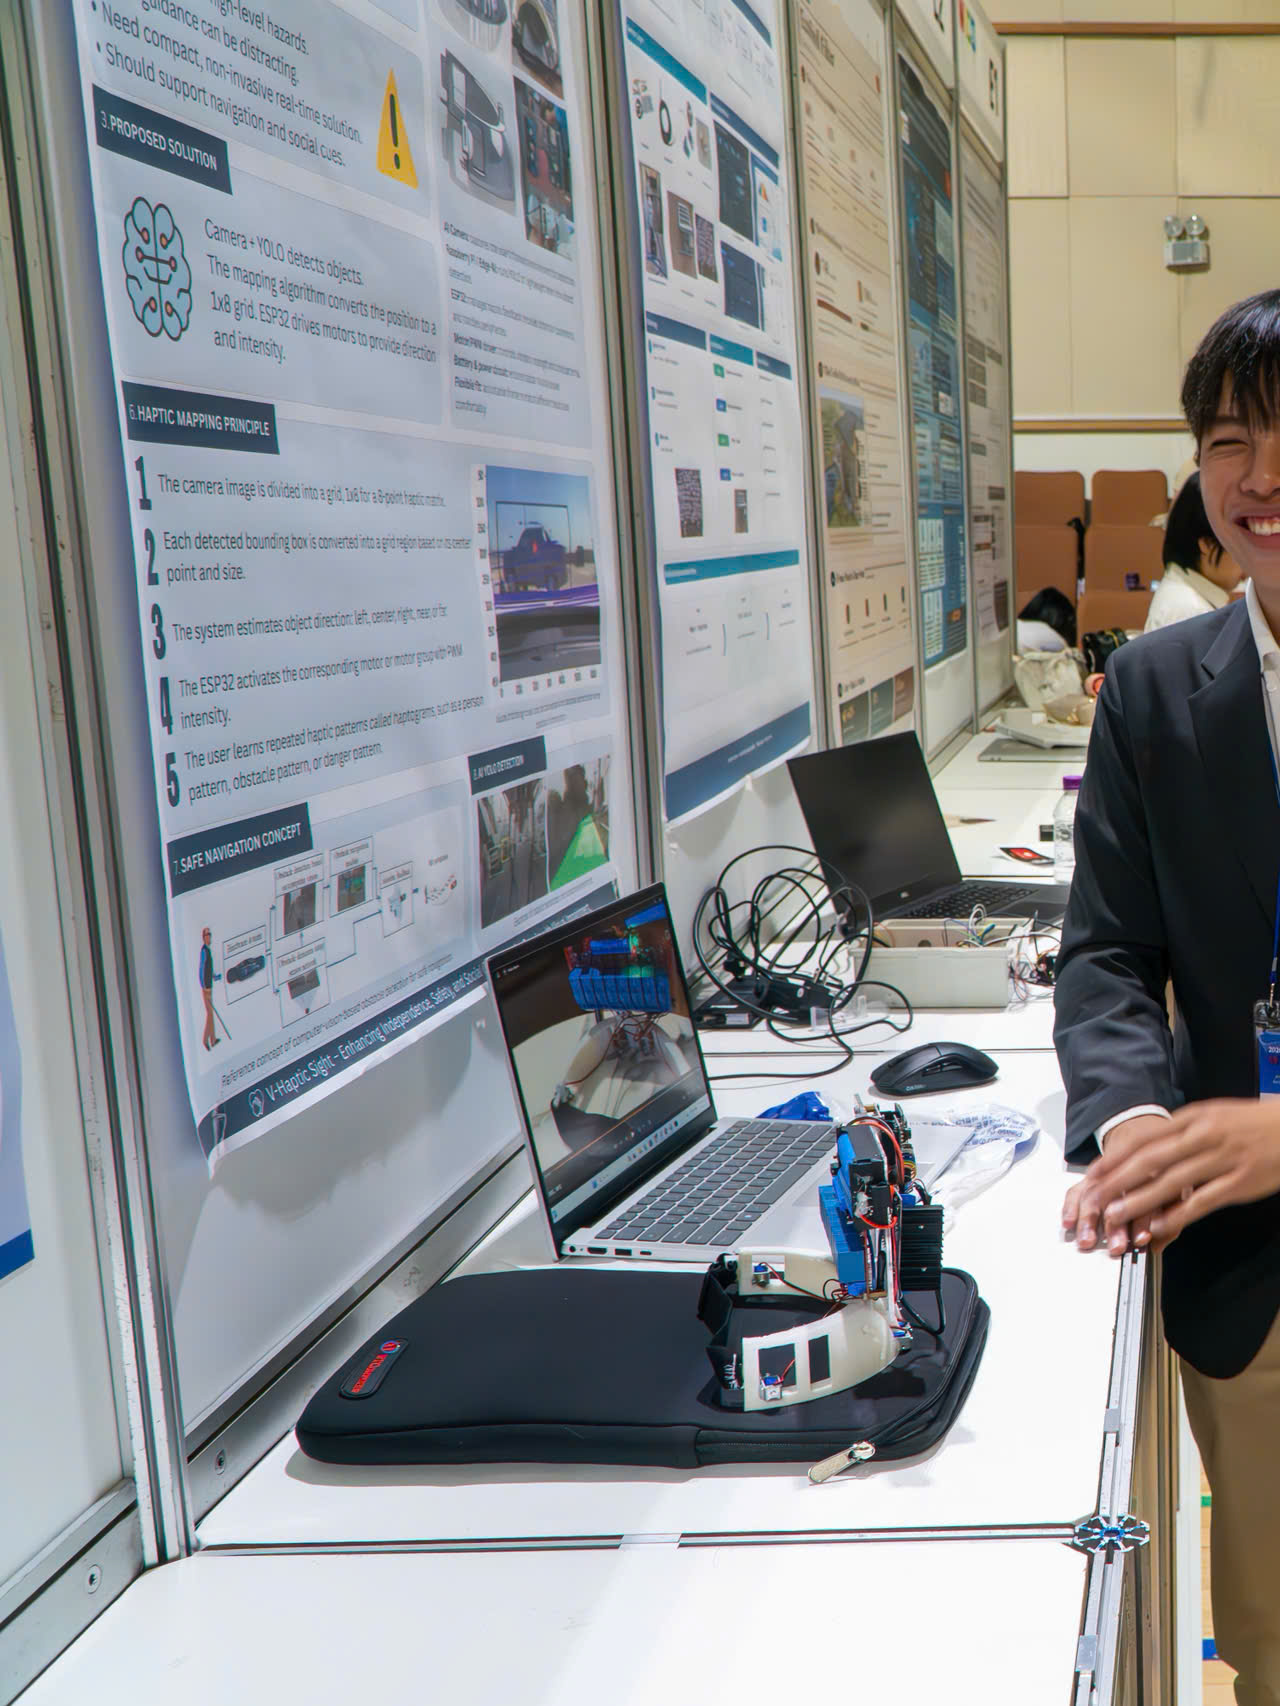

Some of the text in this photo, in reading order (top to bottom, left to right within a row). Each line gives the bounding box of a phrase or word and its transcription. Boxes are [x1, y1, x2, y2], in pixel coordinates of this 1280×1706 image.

[200, 18, 221, 43] can
[223, 26, 238, 52] be
[239, 38, 300, 87] distracting.
[267, 16, 309, 55] hazards.
[102, 3, 363, 144] Need compact, non-invasive real-time solution.
[105, 42, 346, 167] Should support navigation and social cues.
[167, 139, 218, 171] SOLUTION
[204, 218, 248, 250] Camera
[256, 235, 285, 262] YOLO
[287, 247, 325, 275] detects
[326, 259, 364, 286] objects.
[206, 254, 231, 279] The
[232, 265, 277, 298] mapping
[279, 276, 326, 305] algorithm
[327, 295, 369, 318] converts
[369, 303, 385, 322] the
[386, 307, 420, 331] position
[420, 317, 431, 334] to
[431, 321, 437, 337] a
[210, 291, 231, 314] 1x8
[233, 298, 258, 321] grid.
[259, 302, 290, 329] ESP32
[291, 312, 321, 337] drives
[322, 323, 356, 345] motors
[357, 329, 368, 347] to
[369, 334, 401, 356] provide
[214, 329, 287, 364] and intensity.
[176, 410, 223, 432] MAPPING
[224, 416, 271, 437] PRINCIPLE
[134, 455, 152, 511] 1
[157, 474, 180, 493] The
[182, 478, 224, 497] camera
[225, 478, 257, 501] image
[257, 479, 266, 497] is
[267, 480, 301, 499] divided
[301, 483, 320, 501] into
[320, 488, 326, 501] a
[144, 527, 160, 586] 2
[163, 531, 192, 550] Each
[194, 531, 243, 551] detected
[245, 531, 290, 554] bounding
[291, 532, 308, 550] box
[308, 533, 317, 550] is
[318, 534, 359, 550] converted
[167, 562, 246, 587] point and size.
[150, 603, 167, 660] 3
[171, 623, 193, 642] The
[194, 622, 235, 645] system
[236, 617, 283, 637] estimates
[284, 614, 313, 635] object
[178, 679, 199, 698] The
[199, 673, 235, 695] ESP32
[236, 669, 281, 691] activates
[281, 664, 298, 682] the
[298, 657, 360, 681] corresponding
[360, 656, 383, 671] motor
[384, 656, 393, 669] or
[159, 676, 173, 735] 4
[180, 705, 232, 729] intensity.
[184, 752, 206, 770] The
[207, 749, 232, 766] user
[232, 740, 264, 760] learns
[265, 729, 306, 757] repeated
[307, 722, 334, 746] haptic
[334, 717, 369, 742] patterns
[369, 711, 393, 731] called
[164, 751, 181, 808] 5
[188, 776, 233, 805] pattern,
[233, 765, 276, 791] obstacle
[276, 758, 312, 783] pattern,
[312, 755, 323, 771] or
[323, 748, 352, 769] danger
[204, 834, 262, 866] NAVIGATION
[262, 821, 302, 848] CONCEPT
[221, 1063, 255, 1087] Reference
[265, 1068, 312, 1102] V-Haptic
[307, 1053, 336, 1078] Sight
[337, 1023, 387, 1061] Enhancing
[379, 997, 436, 1036] Independence,
